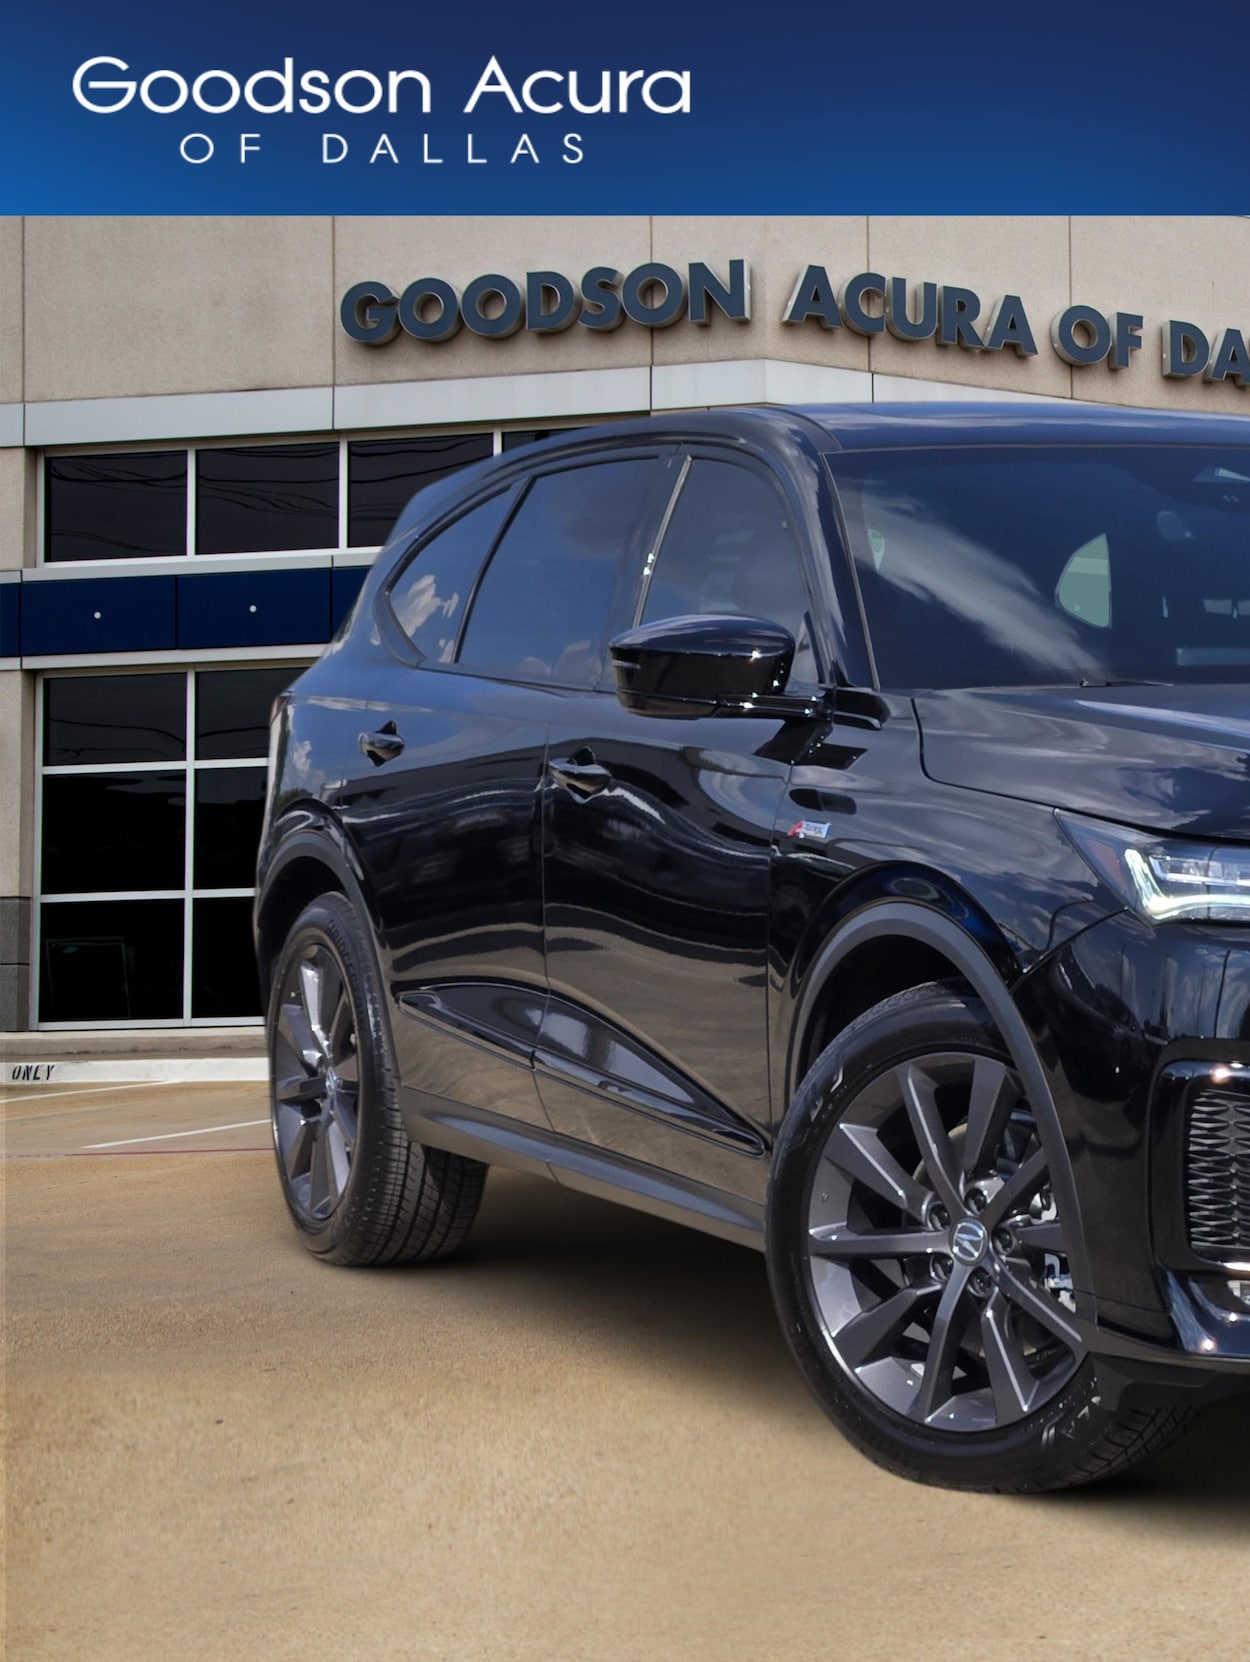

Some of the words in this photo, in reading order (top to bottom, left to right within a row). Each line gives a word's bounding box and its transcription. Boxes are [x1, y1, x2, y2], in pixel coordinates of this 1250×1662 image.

[340, 259, 752, 346] GOODSON
[783, 264, 1038, 356] ACURA
[1051, 305, 1144, 370] OF
[12, 1064, 55, 1081] ONLY
